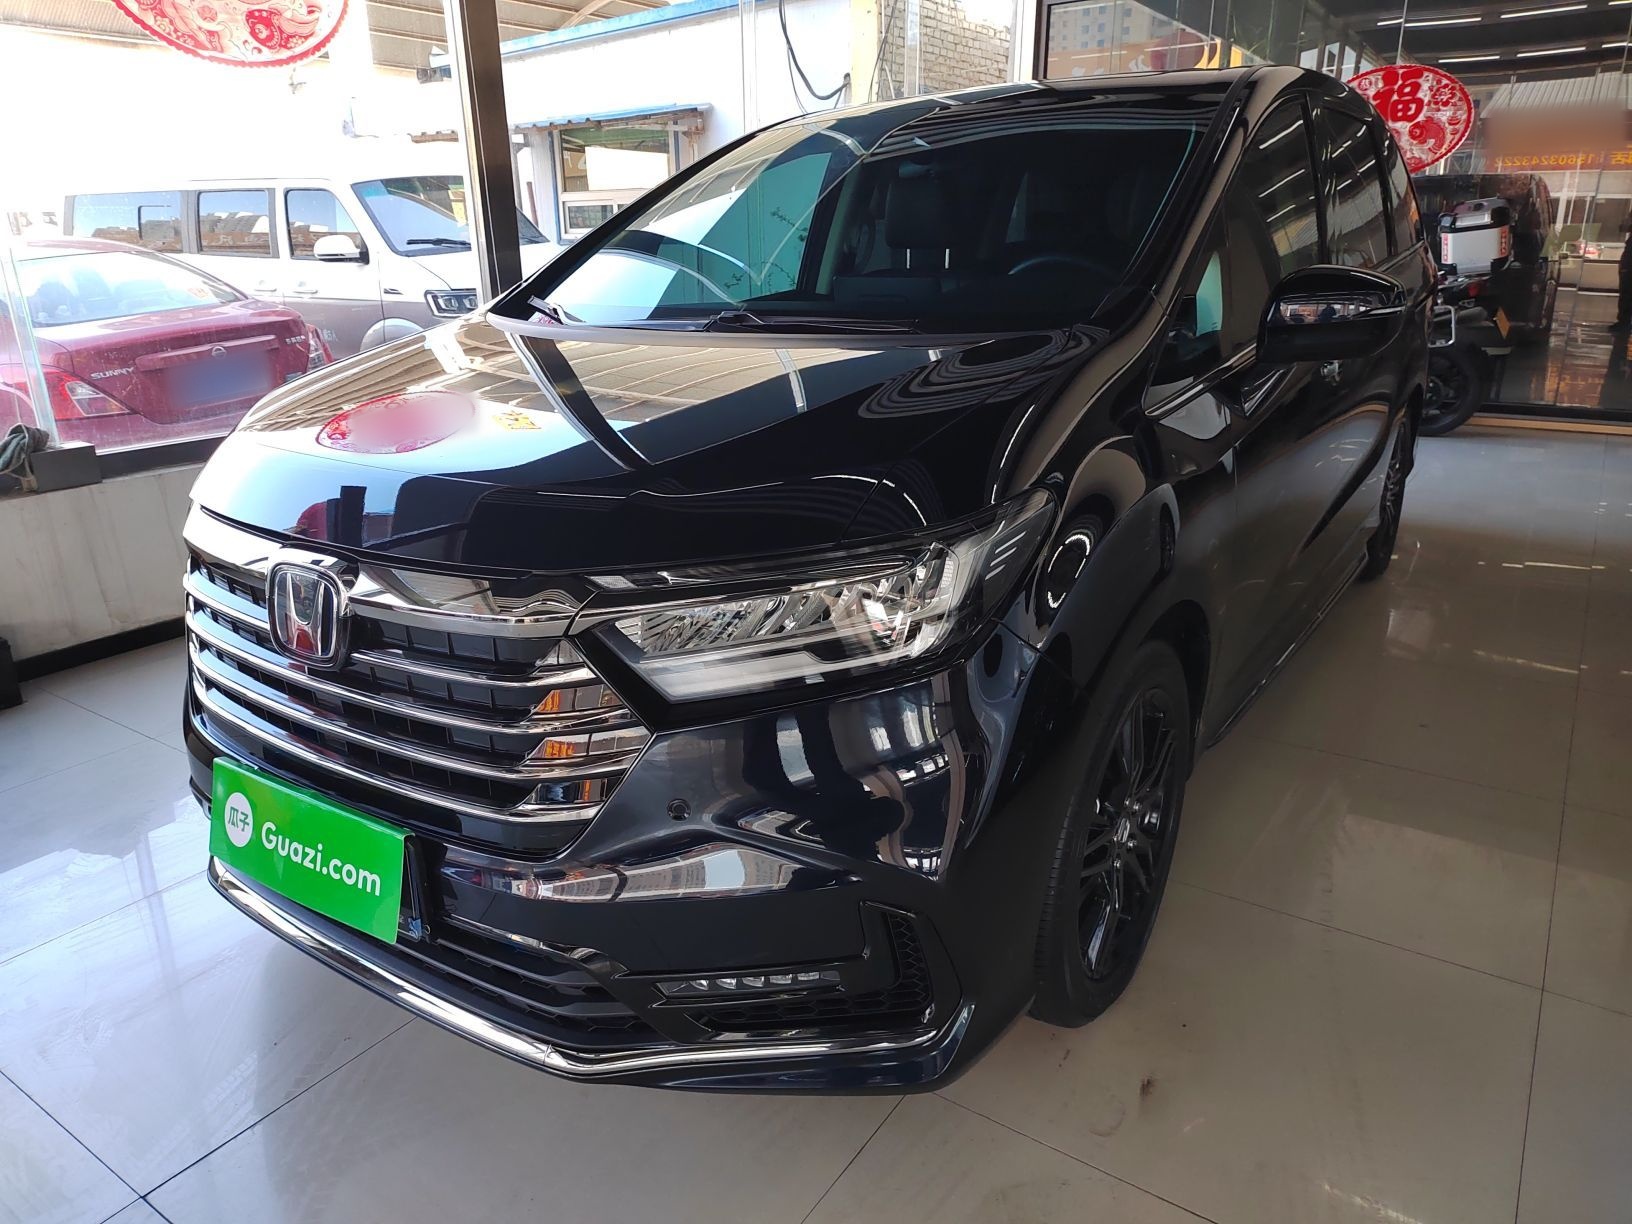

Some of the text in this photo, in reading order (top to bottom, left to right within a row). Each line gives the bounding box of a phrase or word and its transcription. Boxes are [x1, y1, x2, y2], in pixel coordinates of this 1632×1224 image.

[1372, 67, 1424, 123] 福
[91, 367, 134, 380] SUNNY
[228, 806, 250, 832] 瓜子
[261, 822, 381, 896] Guazi.com
